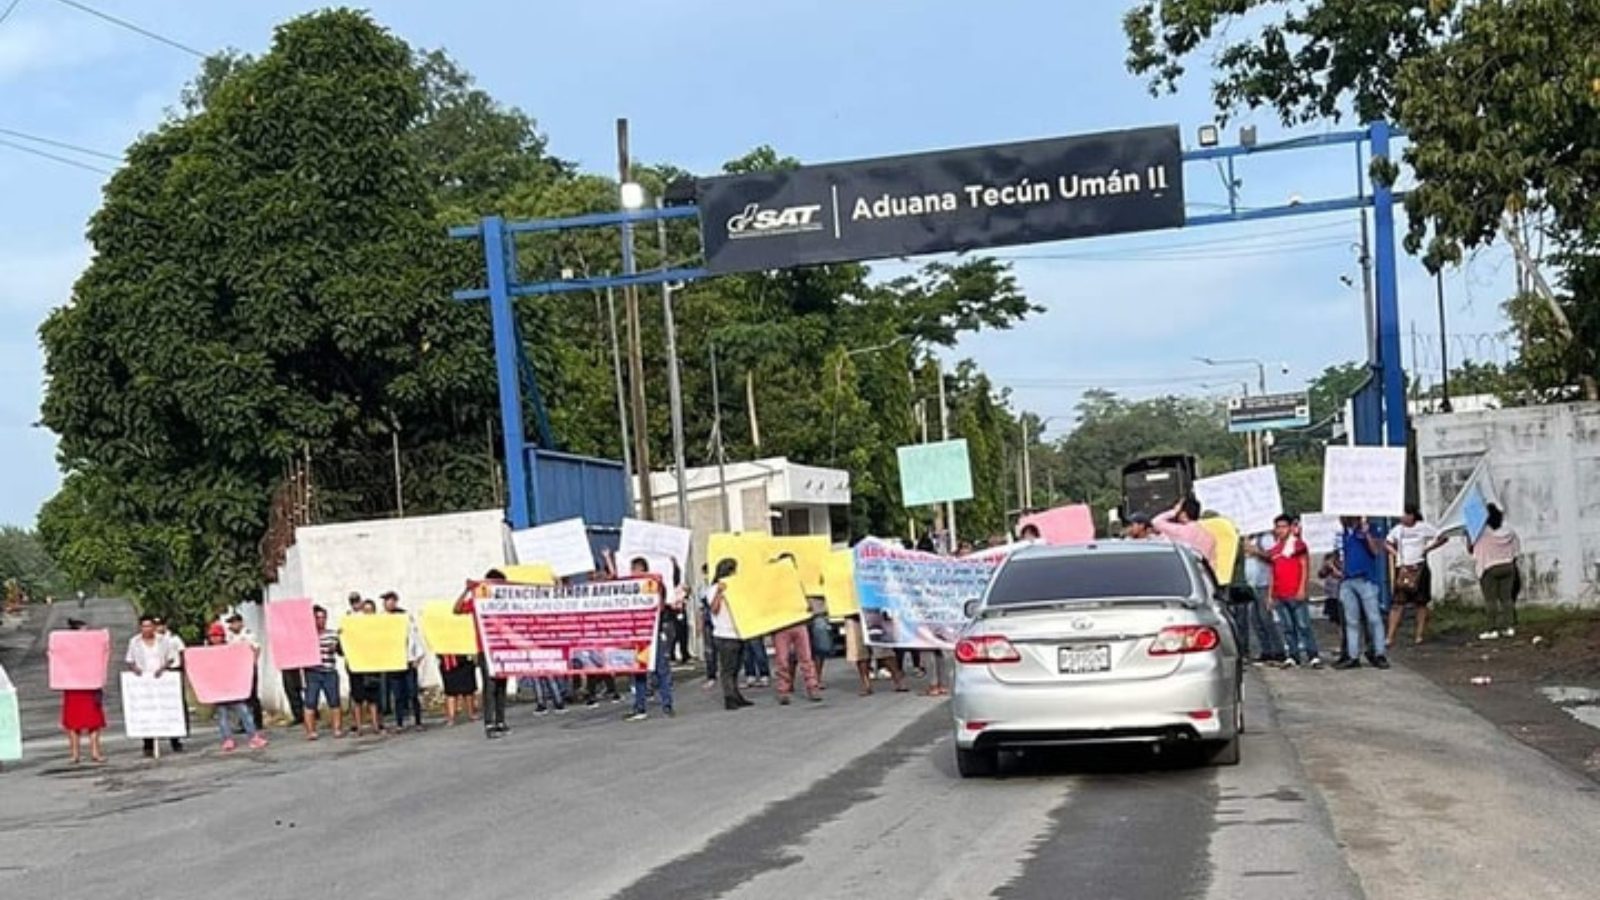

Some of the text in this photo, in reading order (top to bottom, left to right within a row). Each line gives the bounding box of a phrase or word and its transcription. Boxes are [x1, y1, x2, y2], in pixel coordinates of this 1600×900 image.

[852, 193, 957, 220] Aduana
[964, 178, 1050, 208] Tecún
[1059, 169, 1140, 198] Umán
[754, 205, 821, 229] SAT
